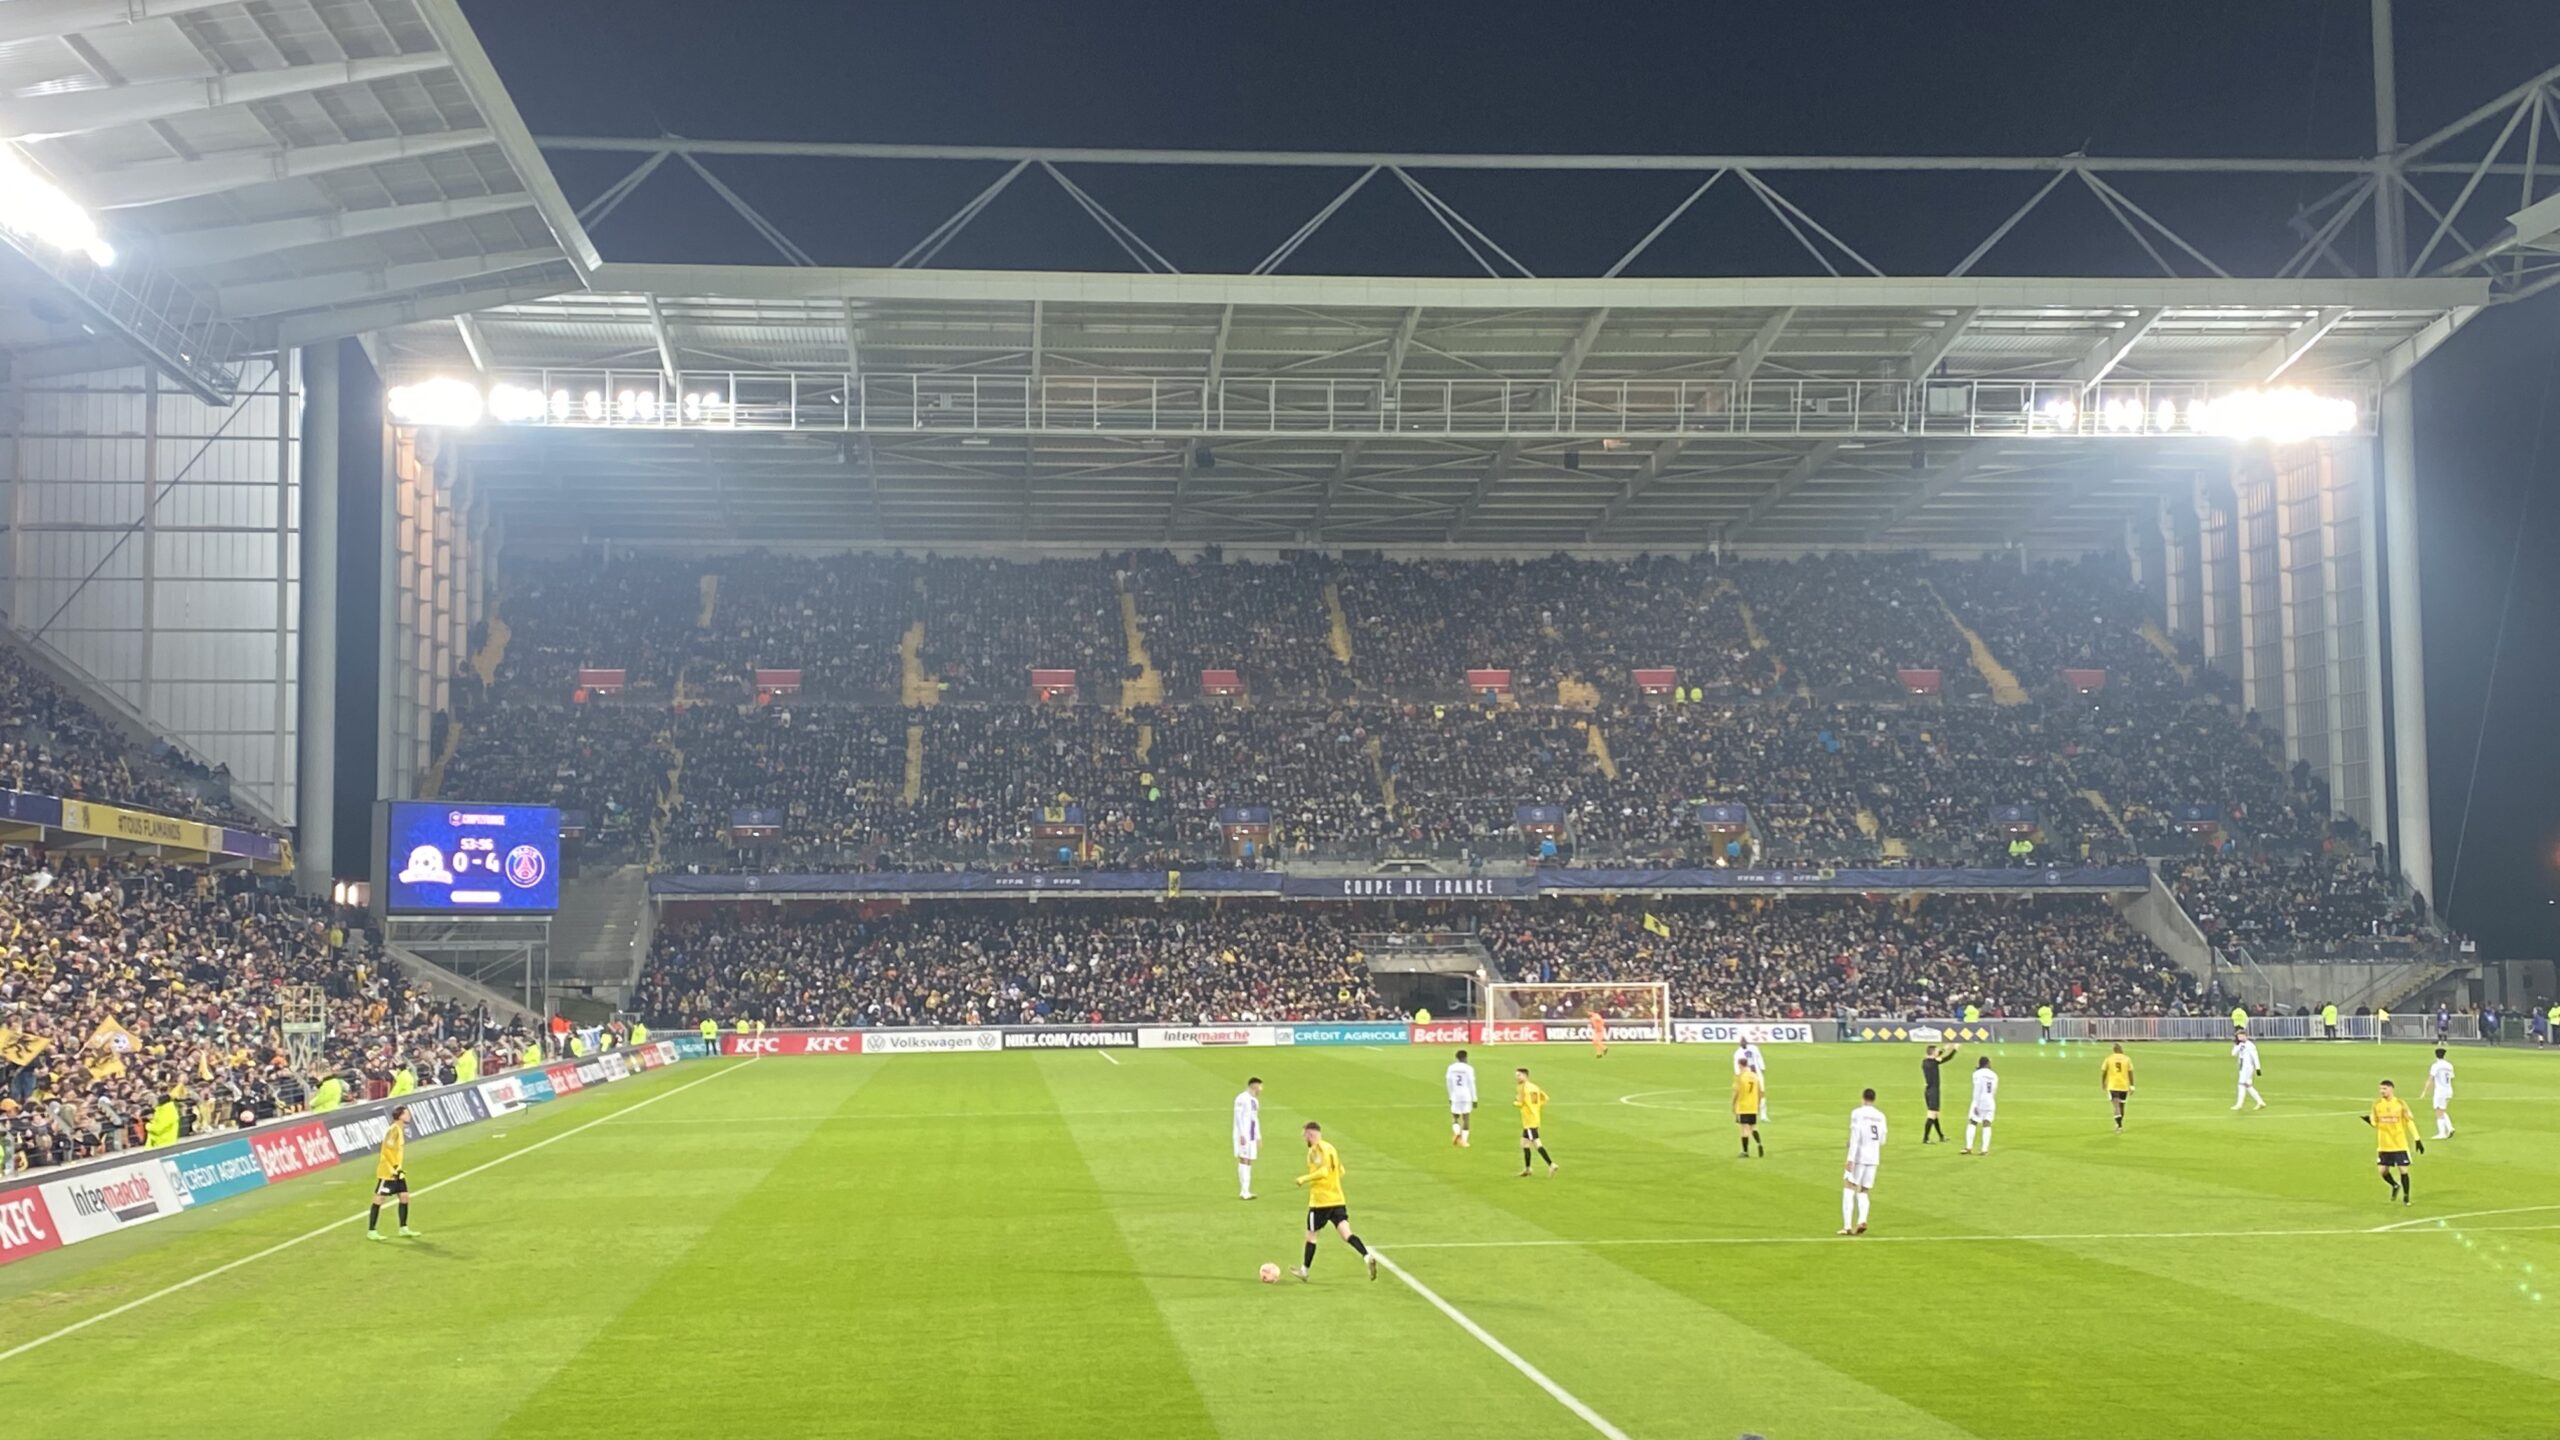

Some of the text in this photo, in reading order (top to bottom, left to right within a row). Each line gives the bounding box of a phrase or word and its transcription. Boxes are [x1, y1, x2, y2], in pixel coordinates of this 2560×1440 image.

[452, 851, 468, 873] 0
[485, 852, 500, 873] 4
[1344, 880, 1493, 894] COUPE DE FRANCE
[890, 1036, 972, 1049] Volkswagen
[1005, 1032, 1135, 1047] NIKE.COM/FOOTBALL
[1295, 1030, 1407, 1041] CRÉDIT AGRICOLE
[1414, 1027, 1469, 1043] Betclic
[735, 1037, 780, 1052] KFC
[804, 1036, 849, 1051] KFC
[1871, 1125, 1879, 1140] 9
[255, 1127, 336, 1178] Betclic Betclic
[183, 1153, 261, 1191] CRÉDIT AGRICOLE
[68, 1172, 154, 1220] Intermarché
[0, 1197, 46, 1249] KFC
